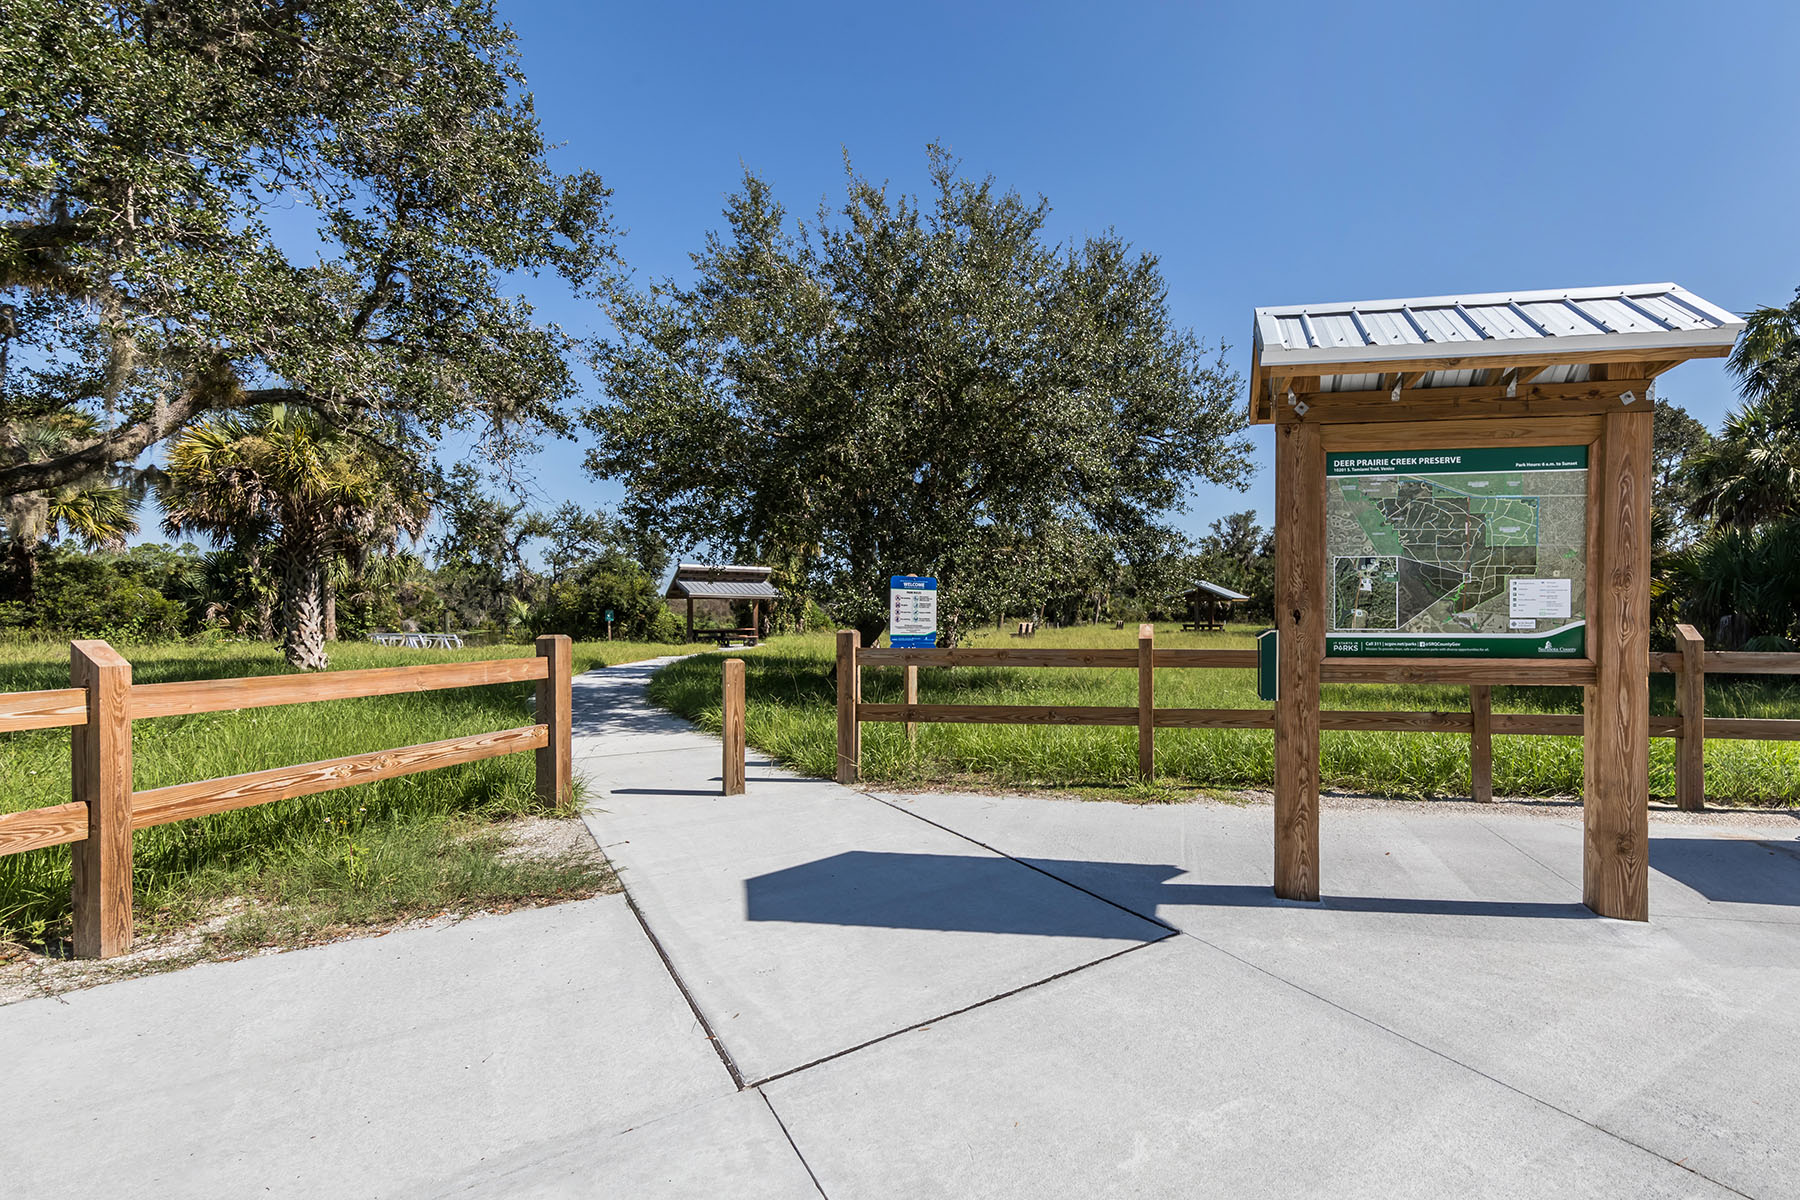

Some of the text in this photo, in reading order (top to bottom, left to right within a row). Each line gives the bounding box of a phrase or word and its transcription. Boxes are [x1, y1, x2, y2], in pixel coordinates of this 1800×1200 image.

[1357, 459, 1388, 467] PRAIRIE
[1390, 457, 1418, 466] CREEK
[1418, 456, 1461, 464] PRESERVE
